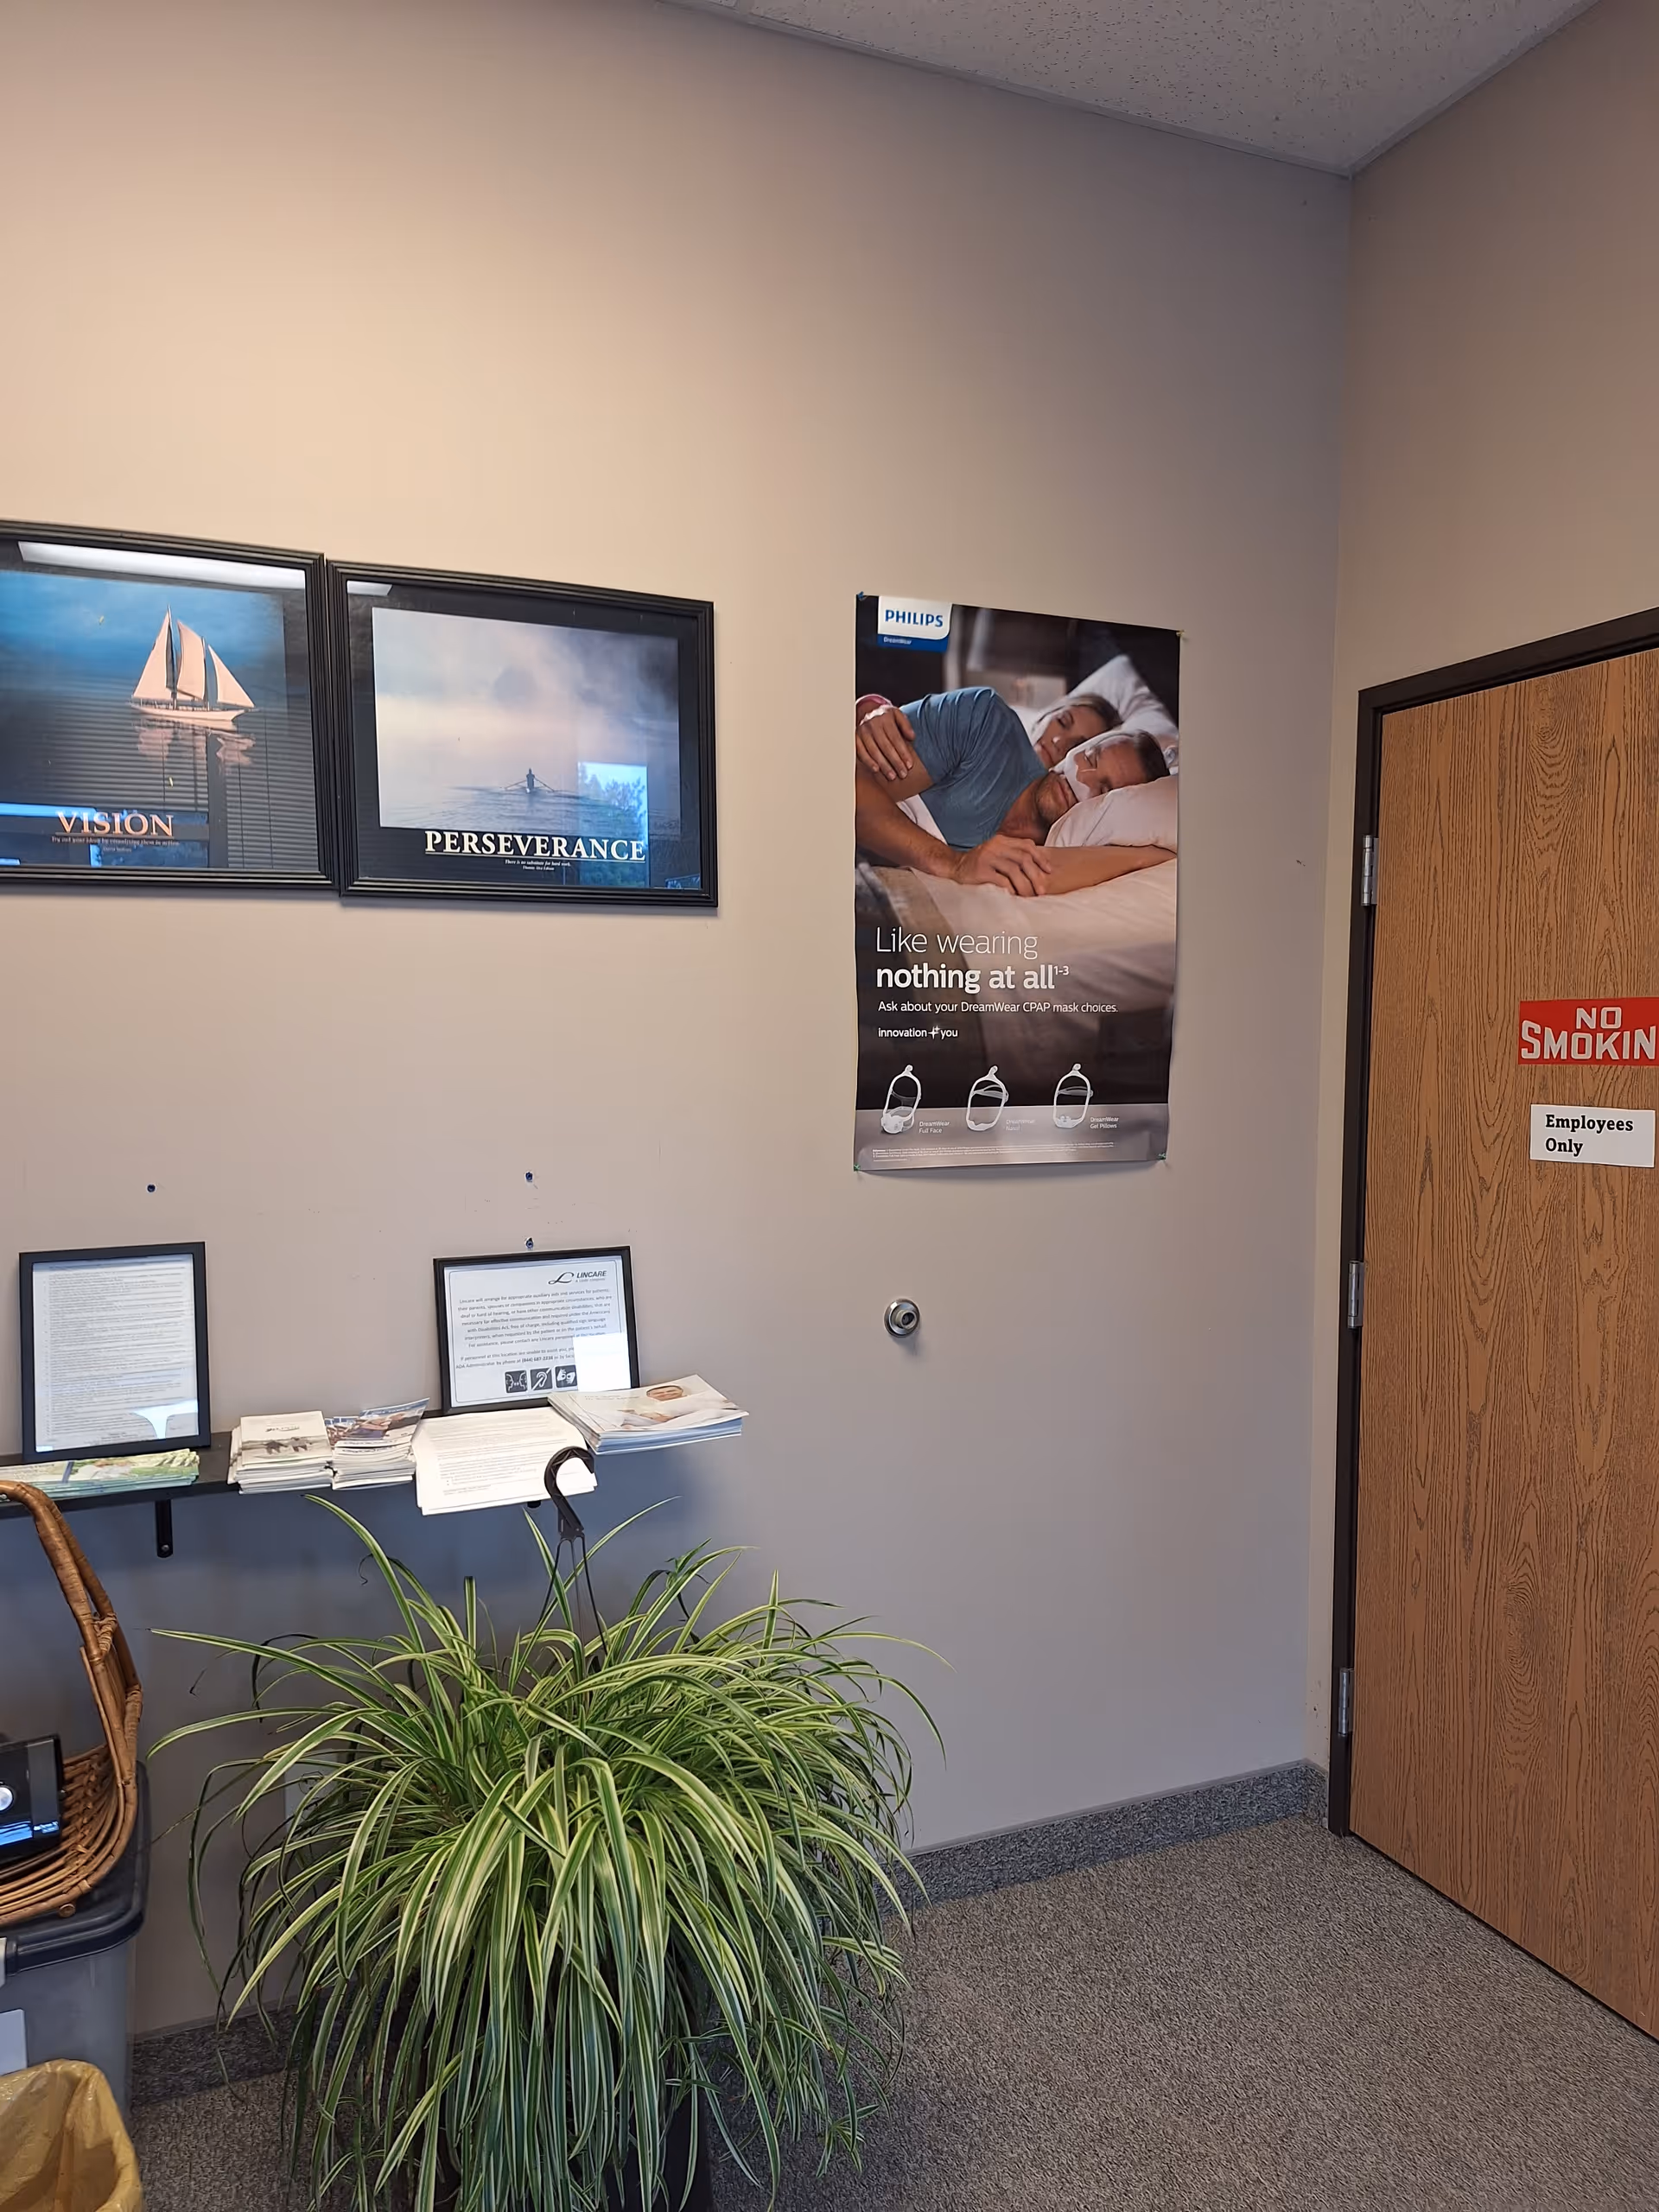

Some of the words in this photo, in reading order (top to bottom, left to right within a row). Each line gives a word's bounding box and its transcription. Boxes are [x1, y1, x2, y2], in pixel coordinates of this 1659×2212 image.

[886, 609, 944, 627] PHILIPS
[56, 811, 175, 837] VISION
[425, 830, 645, 861] PERSEVERANCE
[877, 926, 927, 953] Like
[937, 931, 1038, 960] wearing
[877, 963, 981, 994] nothing
[989, 966, 1015, 989] at
[878, 1001, 898, 1013] Ask
[901, 1001, 932, 1013] about
[935, 1003, 958, 1014] your
[961, 1001, 1020, 1013] DreamWear
[1023, 1002, 1050, 1013] CPAP
[1053, 1002, 1078, 1013] mask
[1081, 1002, 1119, 1013] choices.
[1576, 1007, 1622, 1030] NO
[878, 1027, 927, 1038] innovation
[940, 1029, 958, 1040] you
[1522, 1020, 1656, 1060] SMOKIN
[1546, 1115, 1633, 1134] Employees
[1546, 1138, 1583, 1157] Only
[577, 1270, 607, 1279] LINCARE
